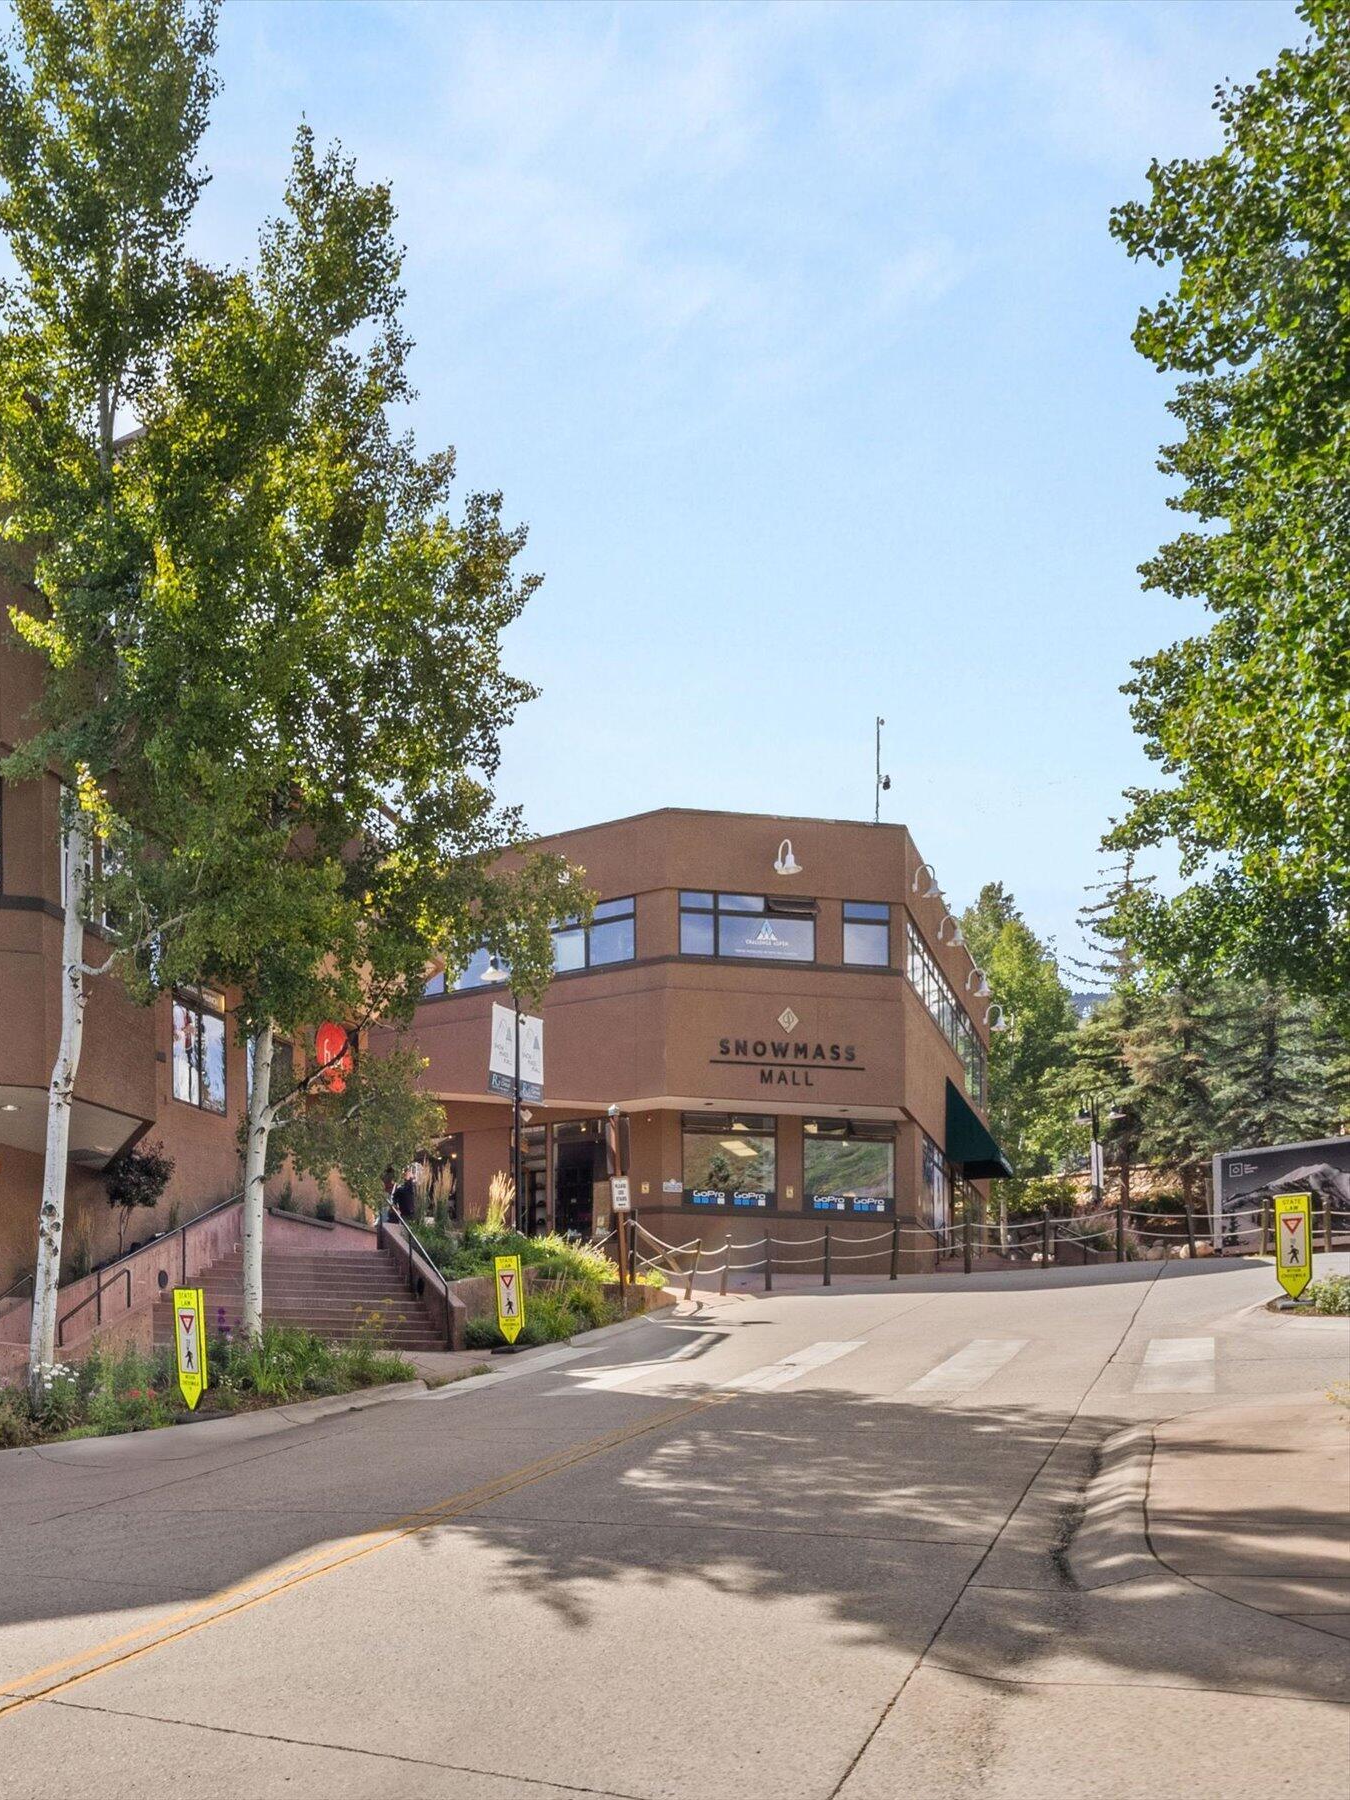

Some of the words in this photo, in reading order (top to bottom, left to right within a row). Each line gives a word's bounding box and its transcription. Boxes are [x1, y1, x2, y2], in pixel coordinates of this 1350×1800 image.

[719, 1038, 856, 1062] SNOWMASS
[760, 1069, 814, 1087] MALL
[692, 1190, 726, 1198] GoPro
[733, 1191, 766, 1200] GoPro
[813, 1195, 845, 1203] GoPro
[853, 1197, 885, 1205] GoPro
